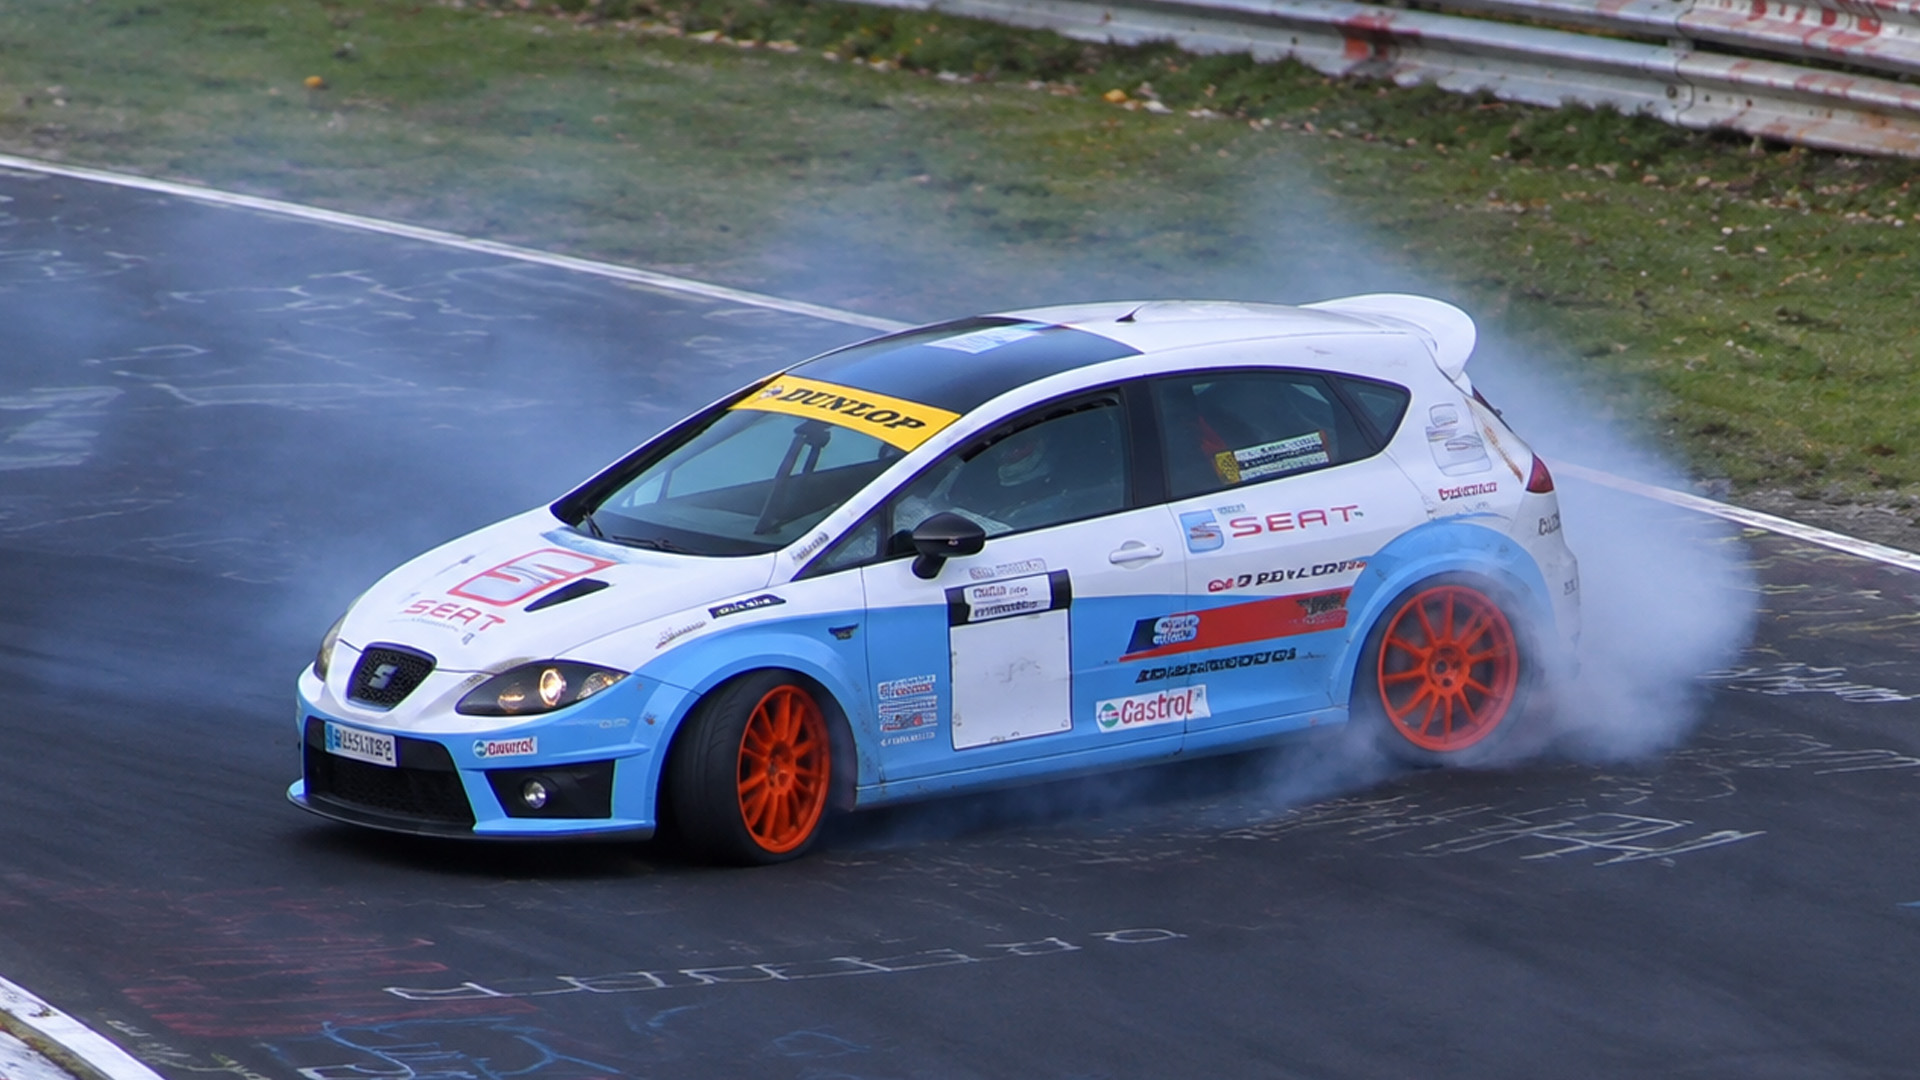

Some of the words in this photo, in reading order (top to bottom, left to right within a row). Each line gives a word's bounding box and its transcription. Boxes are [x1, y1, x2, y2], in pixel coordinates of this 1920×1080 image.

[776, 388, 927, 430] DUNLOP
[1229, 504, 1359, 538] SEAT
[403, 599, 506, 632] SEAT
[1121, 689, 1194, 725] Castrol
